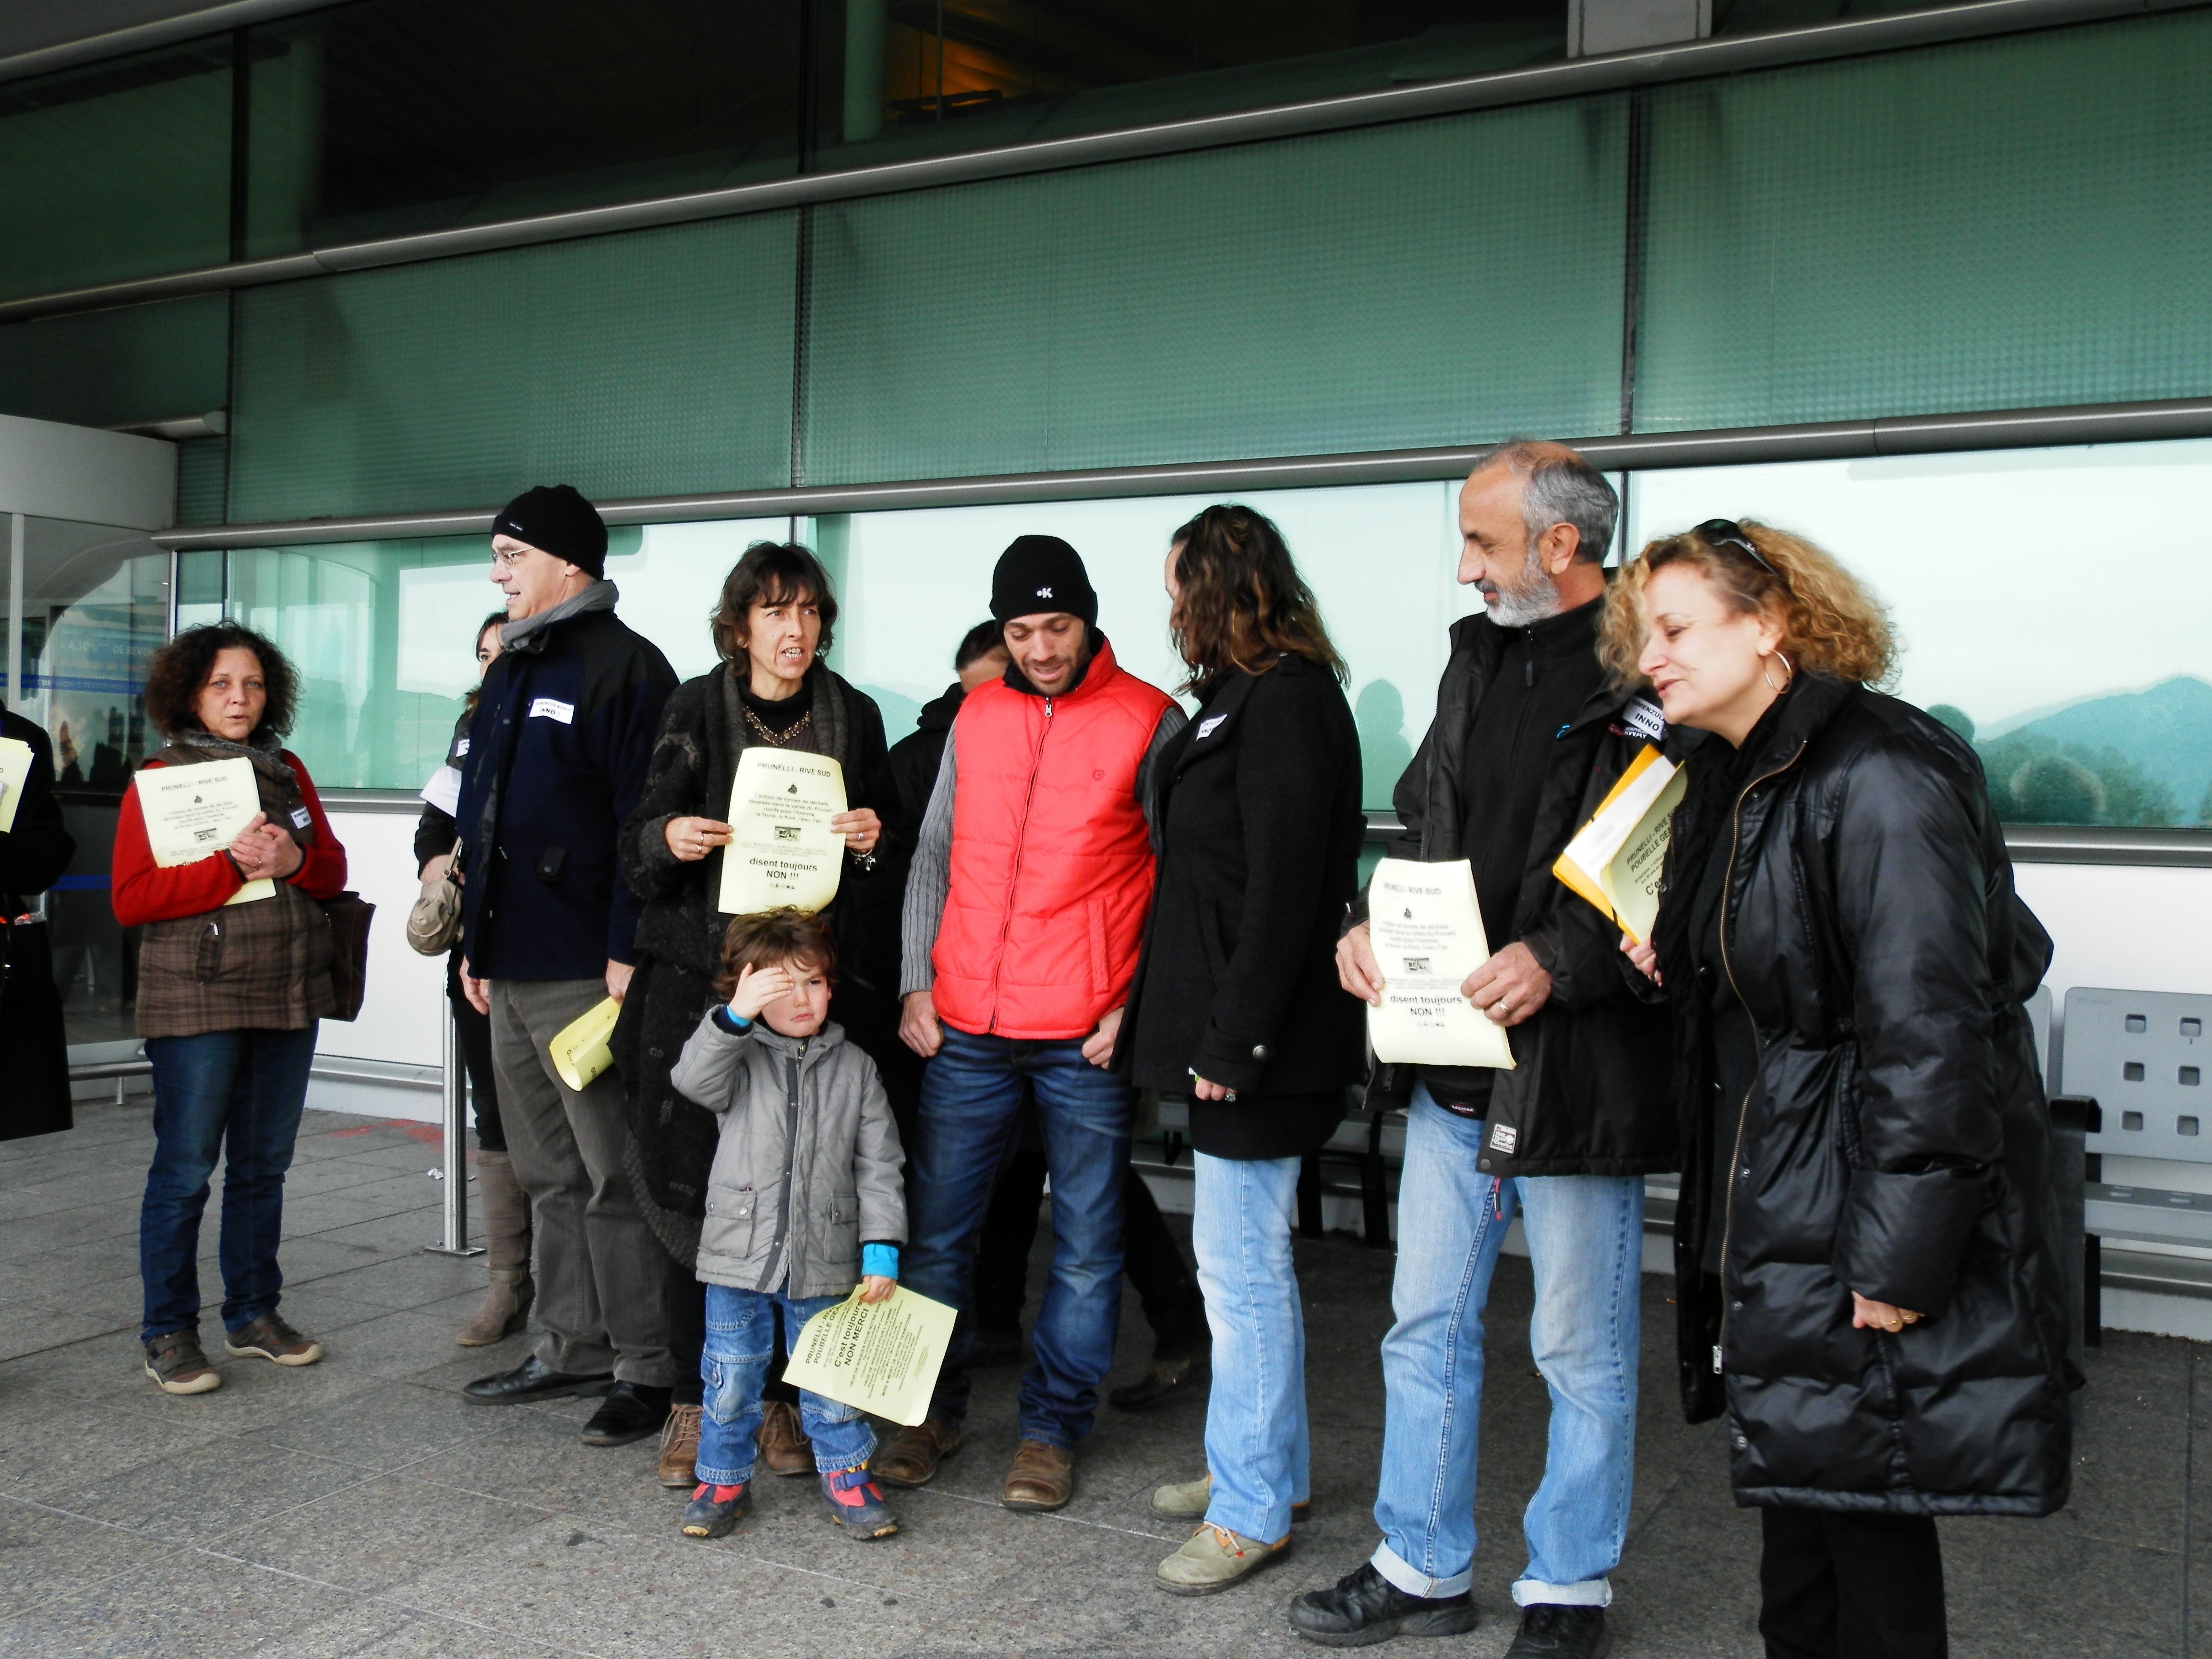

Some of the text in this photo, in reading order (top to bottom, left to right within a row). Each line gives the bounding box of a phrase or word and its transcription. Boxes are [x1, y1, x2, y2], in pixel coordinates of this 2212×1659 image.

[1635, 713, 1659, 731] INNO
[757, 763, 793, 772] PRUNELLI
[162, 782, 193, 791] PRUNELLI
[1627, 834, 1652, 865] PRUNELLI
[1655, 817, 1668, 834] RIVE
[750, 858, 817, 871] disent toujours
[1631, 839, 1660, 873] POUBELLE
[1384, 882, 1405, 893] PRUNELLI
[1421, 996, 1462, 1006] toujours
[806, 1326, 823, 1363] PRUNELLI
[823, 1306, 834, 1319] RIV
[814, 1307, 840, 1363] POUBELLE GEA
[835, 1343, 847, 1367] C'est
[843, 1301, 864, 1339] toujours
[901, 1313, 911, 1339] TERRITOIRE
[844, 1309, 868, 1365] NON MERCI
[857, 1346, 865, 1366] RISQUES
[871, 1345, 879, 1365] RISQUES
